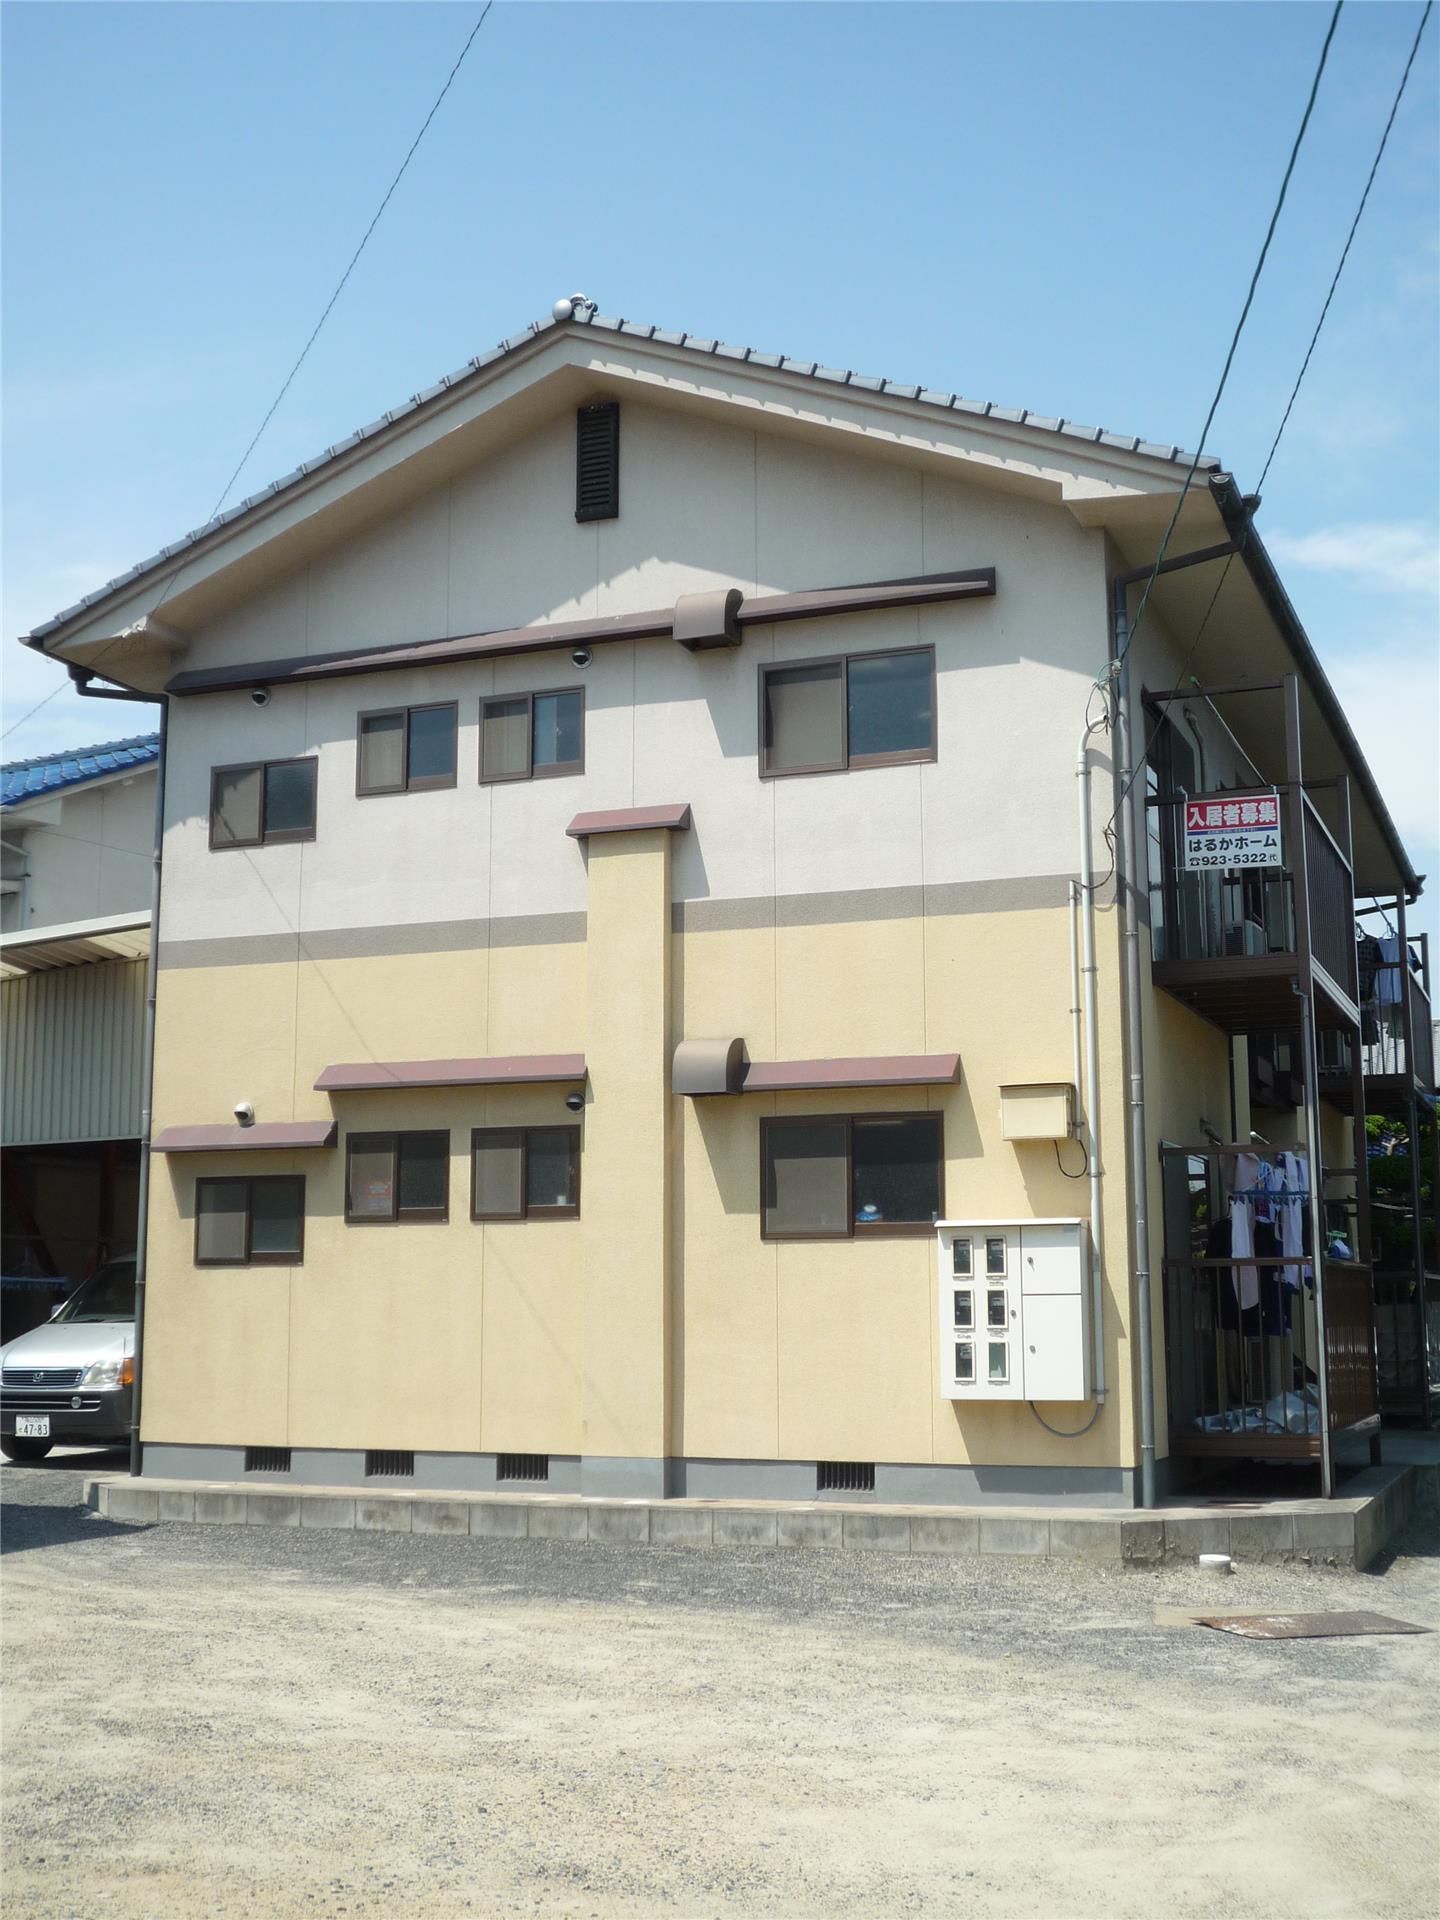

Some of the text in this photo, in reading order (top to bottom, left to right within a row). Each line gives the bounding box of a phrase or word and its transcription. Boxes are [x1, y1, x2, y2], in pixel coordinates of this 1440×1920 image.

[1188, 802, 1276, 827] 入居者募集
[1189, 835, 1277, 852] はるかホーム
